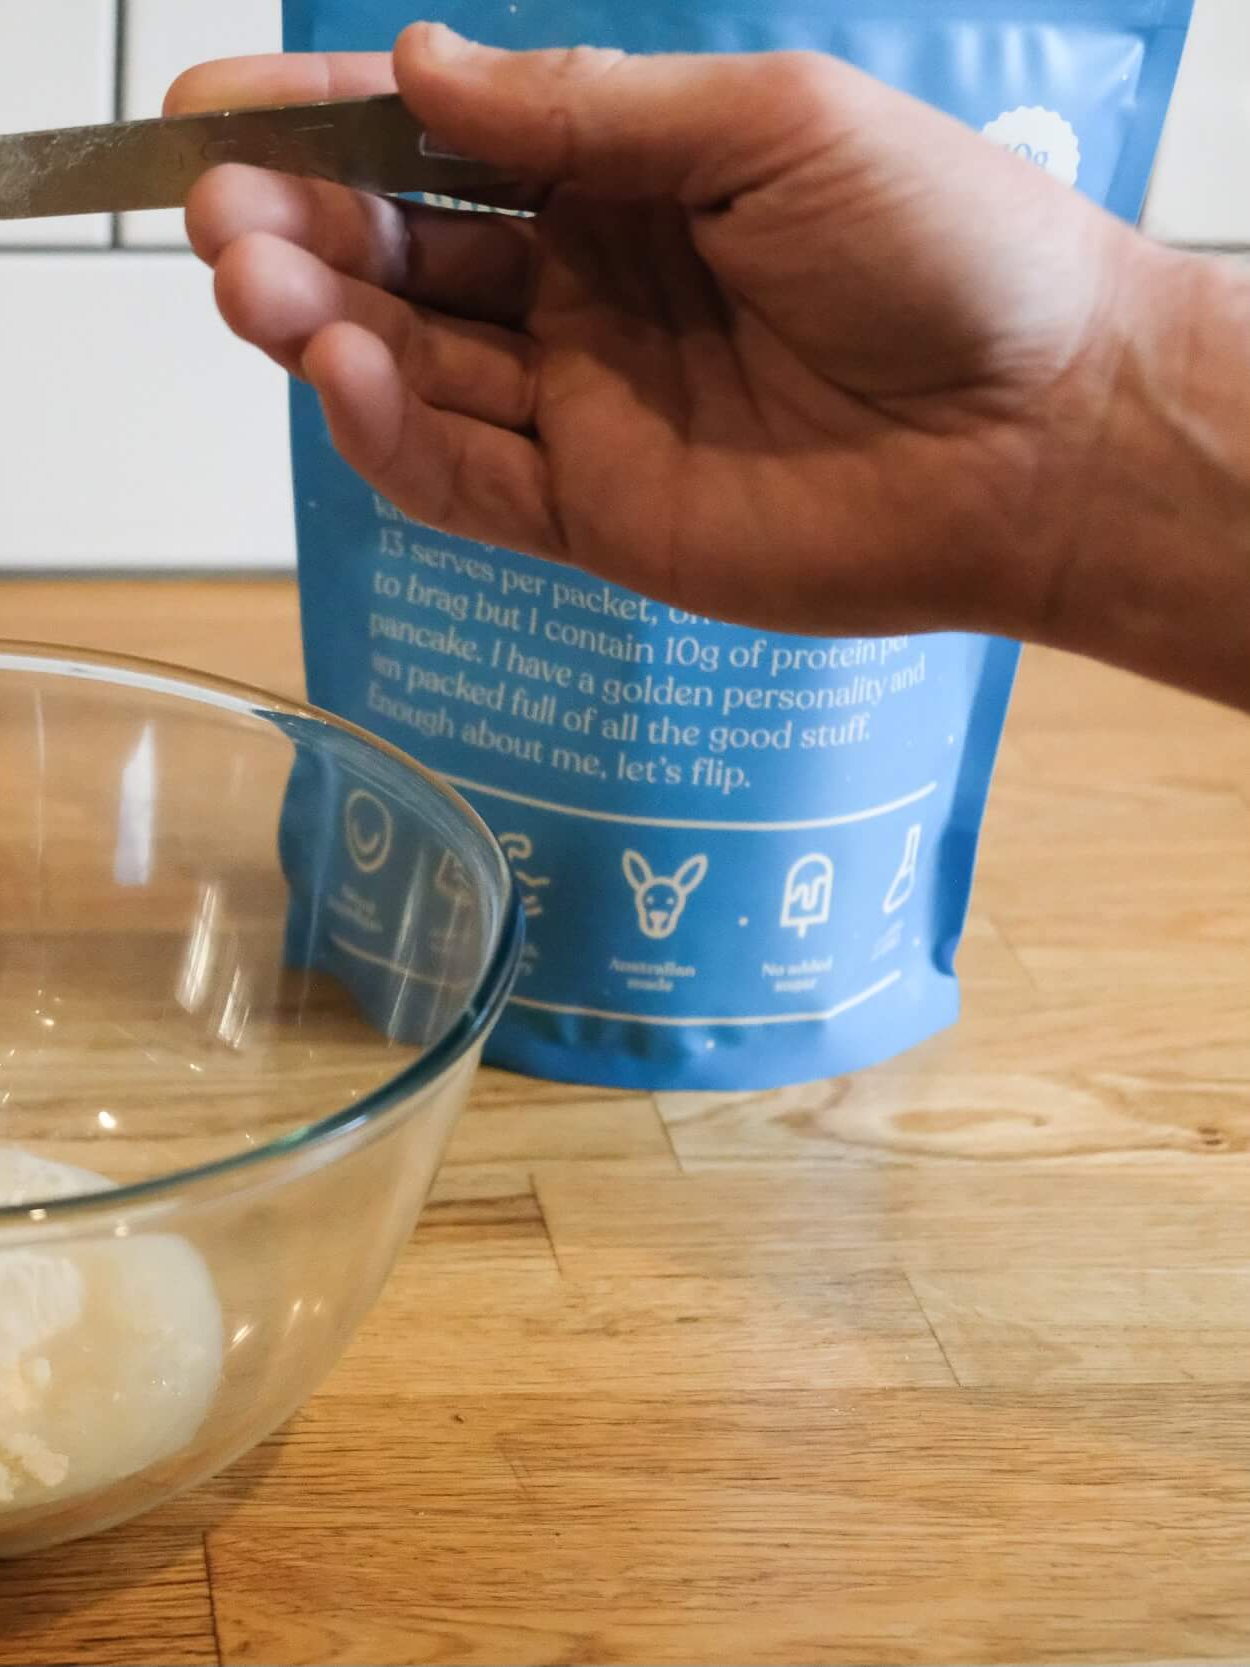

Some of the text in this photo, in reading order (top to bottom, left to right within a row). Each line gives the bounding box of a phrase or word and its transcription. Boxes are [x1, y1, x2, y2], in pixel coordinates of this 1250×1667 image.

[412, 544, 495, 582] serves
[501, 567, 546, 595] per
[370, 613, 482, 662] pancake.
[508, 644, 572, 687] have
[578, 672, 595, 694] a
[602, 676, 713, 705] golden
[721, 668, 885, 715] personality
[890, 653, 925, 692] and
[374, 570, 399, 596] to
[407, 574, 467, 620] brag
[475, 593, 519, 630] but
[545, 620, 653, 665] contain
[665, 635, 718, 671] 10g
[729, 639, 766, 668] of
[771, 638, 874, 676] protein
[881, 634, 910, 662] per
[369, 679, 454, 738] Enough
[461, 718, 544, 763] about
[617, 753, 681, 783] let's
[691, 757, 750, 795] flip.
[407, 665, 505, 711] packed
[512, 688, 556, 726] full
[563, 705, 598, 736] of
[602, 713, 637, 742] all
[647, 716, 699, 746] the
[707, 721, 792, 752] good
[800, 713, 871, 748] stuff.
